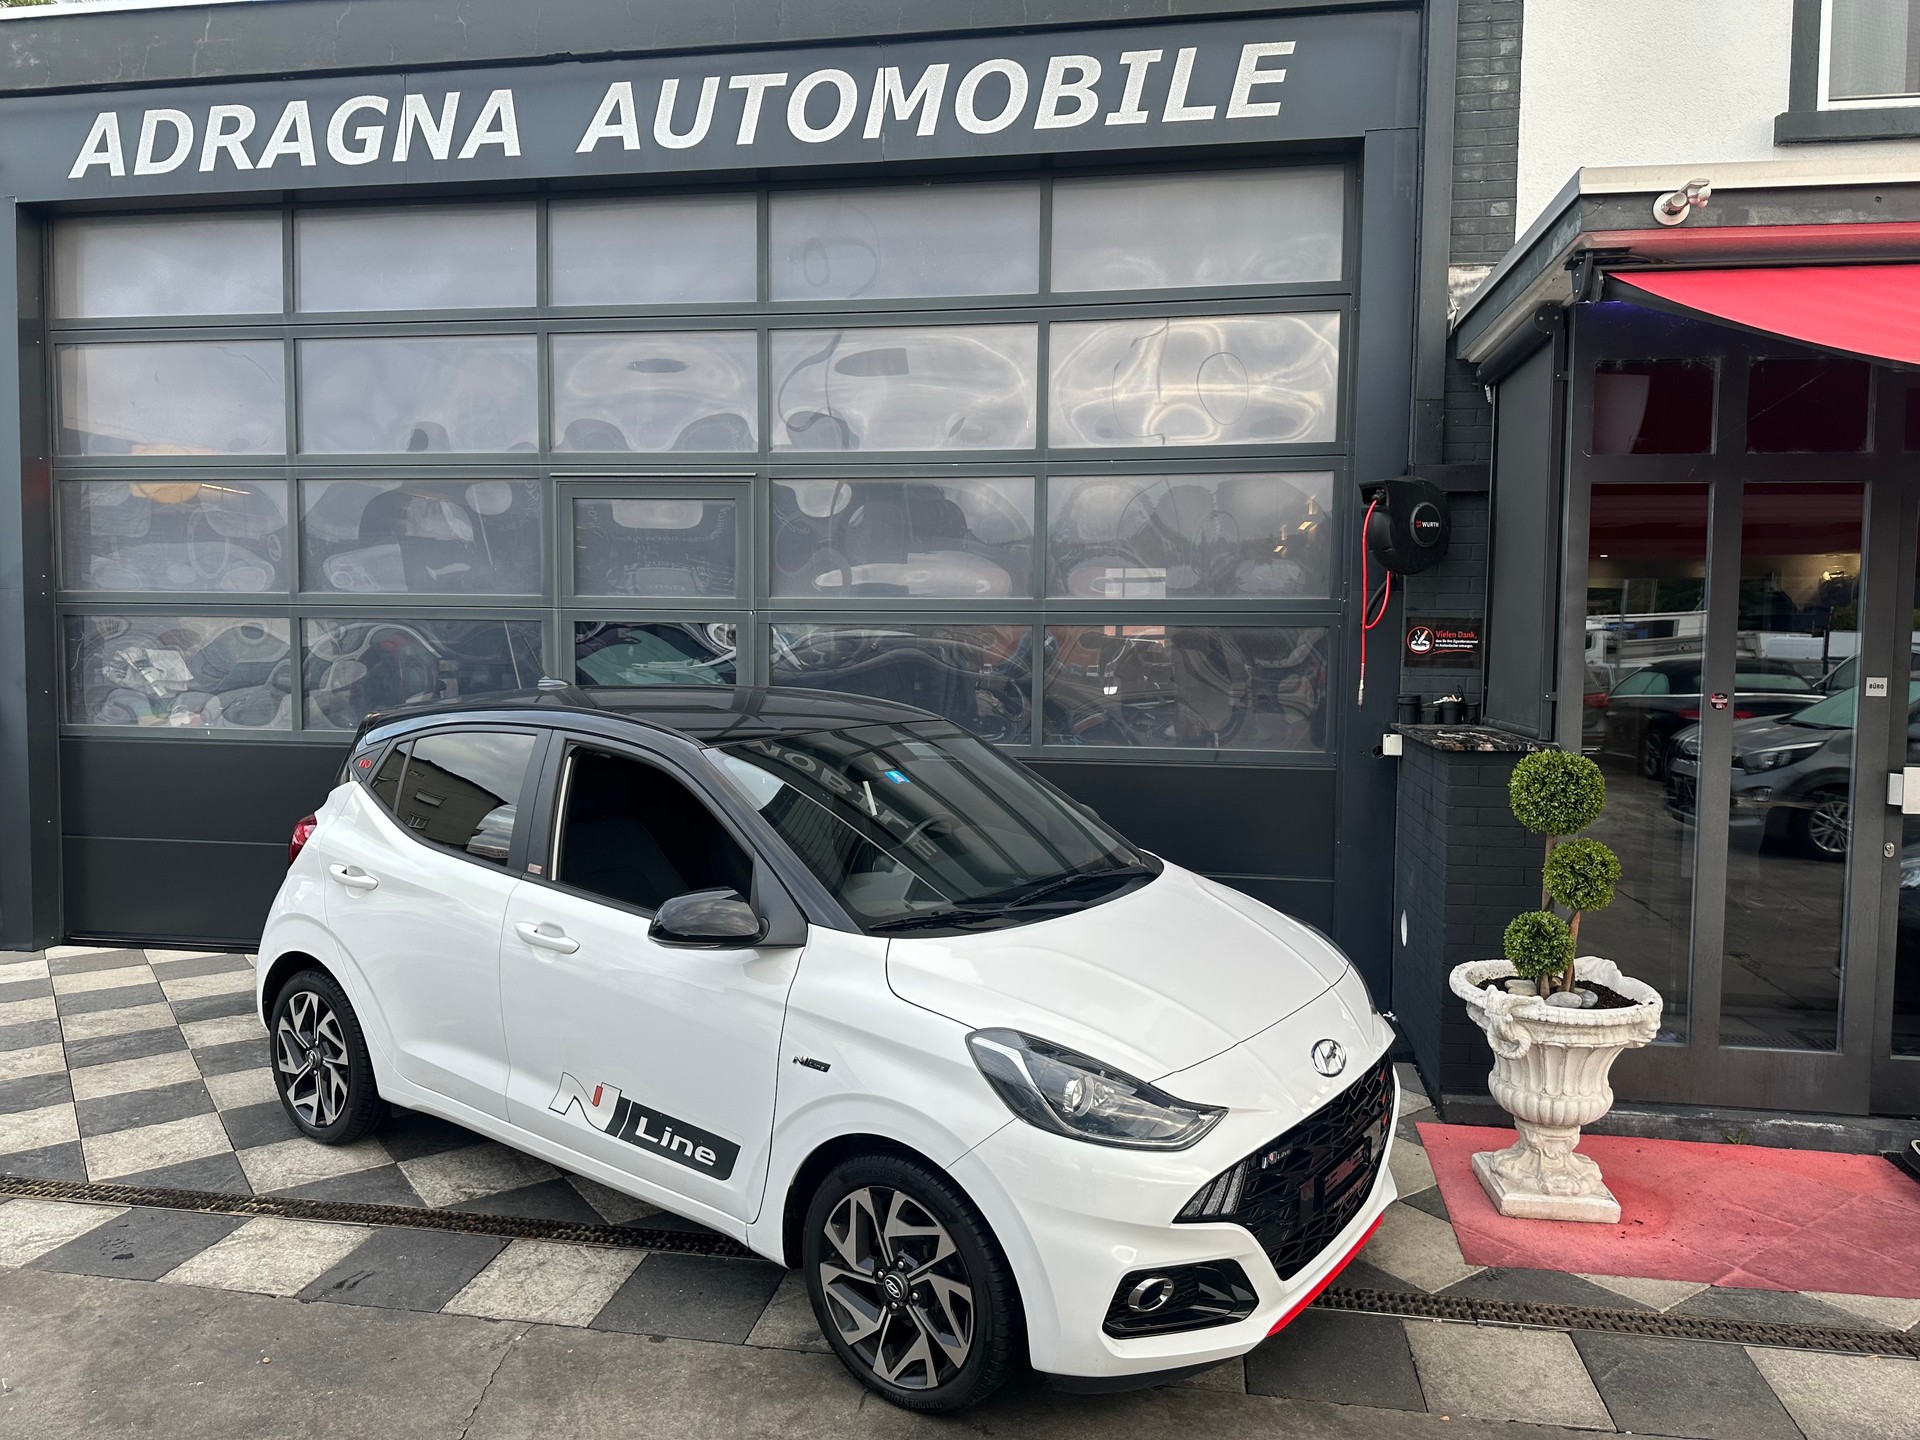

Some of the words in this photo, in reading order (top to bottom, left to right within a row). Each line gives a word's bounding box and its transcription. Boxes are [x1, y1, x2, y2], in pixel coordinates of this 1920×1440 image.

[67, 88, 522, 179] ADRAGNA
[575, 40, 1297, 153] AUTOMOBILE
[1435, 630, 1457, 638] Vielen
[634, 1115, 717, 1167] Line
